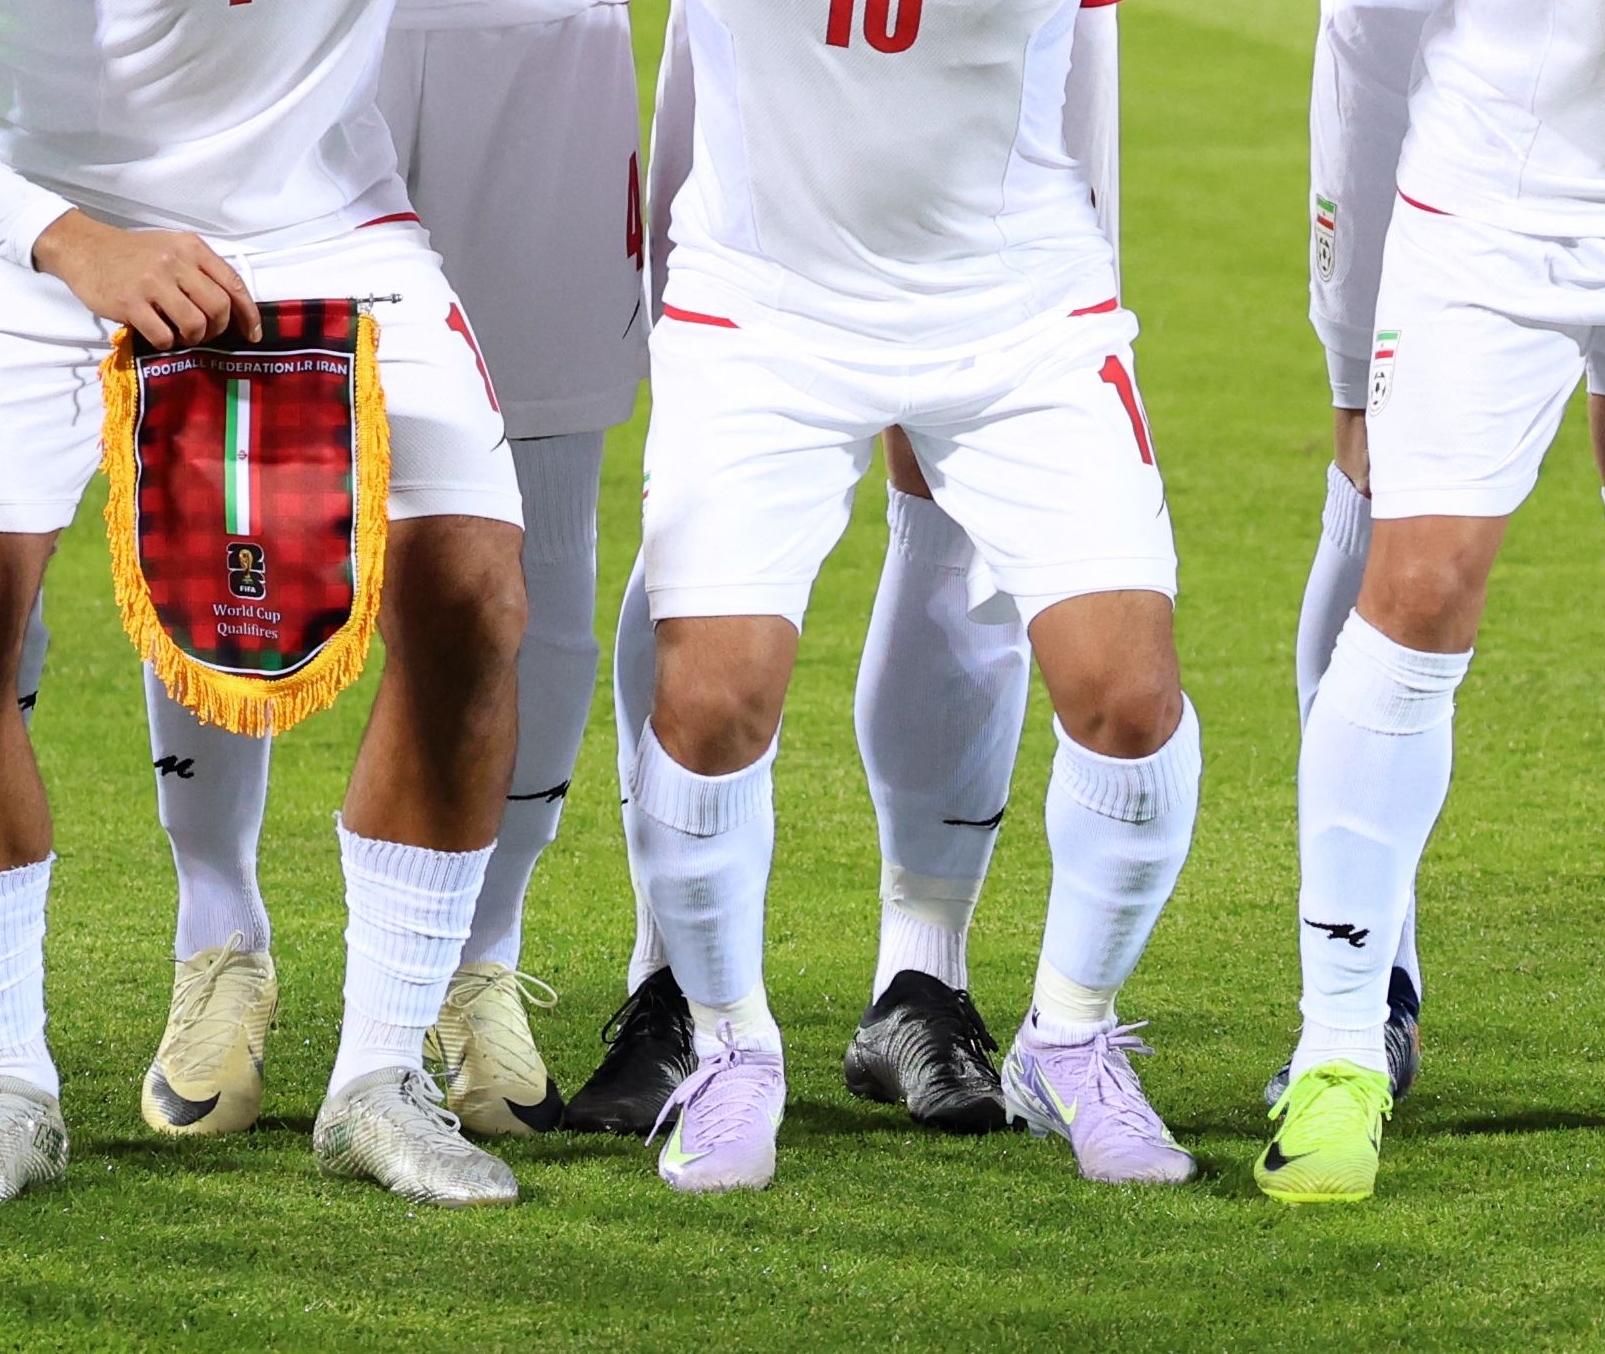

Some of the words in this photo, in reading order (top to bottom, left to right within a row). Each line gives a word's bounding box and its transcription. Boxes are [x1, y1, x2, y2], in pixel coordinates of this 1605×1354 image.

[143, 359, 206, 378] FOOTBALL
[210, 360, 294, 374] FEDERATION
[296, 360, 313, 372] I.R
[316, 360, 348, 375] IRAN
[1097, 354, 1154, 466] 1
[239, 585, 257, 593] FIFA
[213, 604, 255, 618] World
[256, 607, 281, 624] Cup
